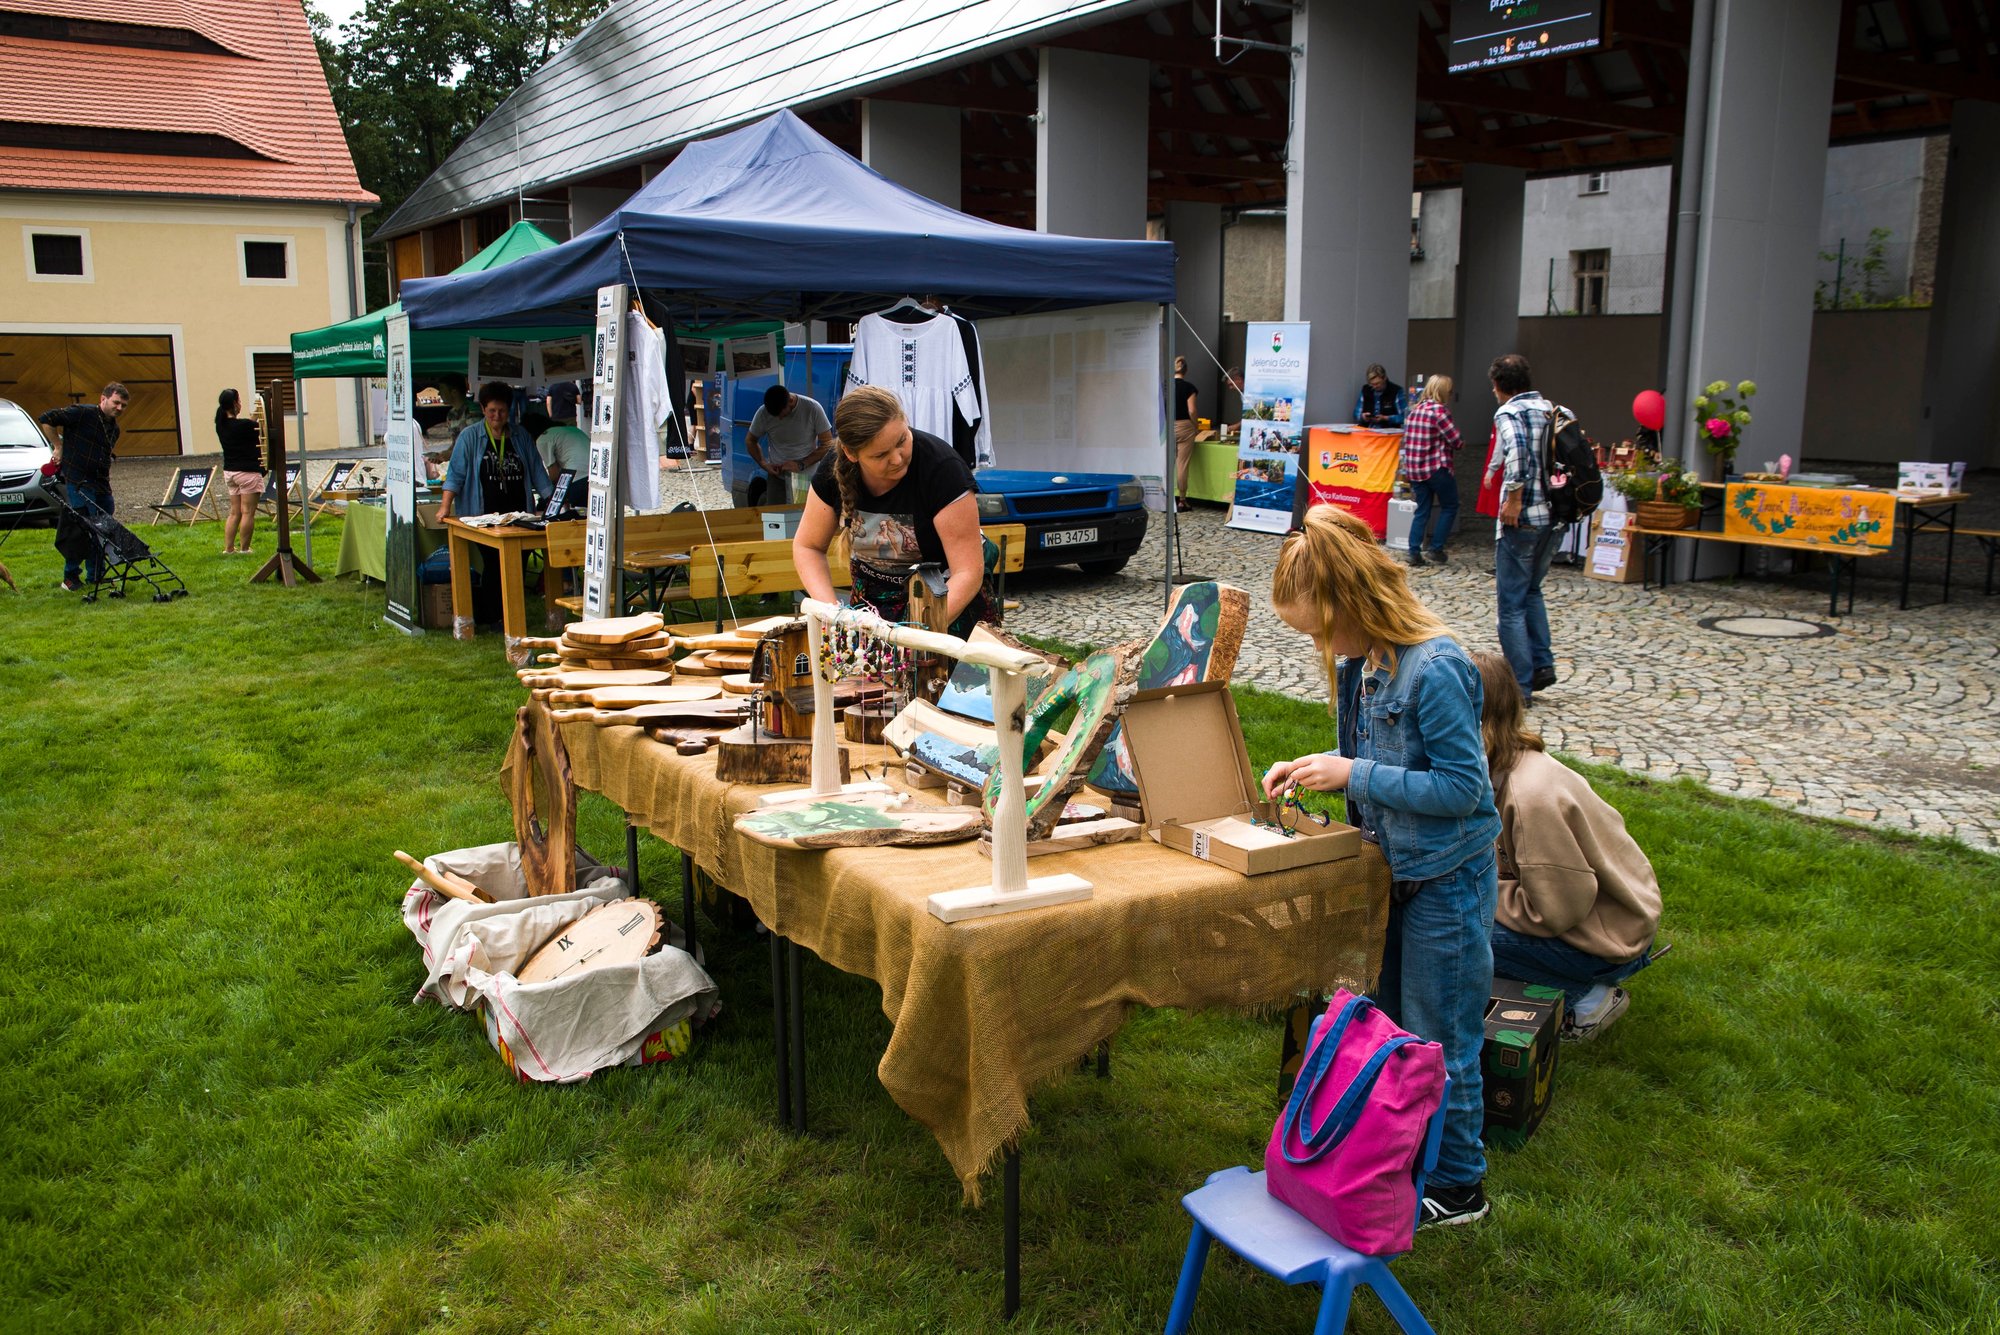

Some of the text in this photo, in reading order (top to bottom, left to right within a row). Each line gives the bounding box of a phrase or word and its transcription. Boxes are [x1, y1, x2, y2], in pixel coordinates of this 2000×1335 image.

[1488, 40, 1537, 56] 19.8 duże
[1251, 357, 1300, 368] Jelenia Góra
[1333, 452, 1359, 462] JELENIA
[1046, 529, 1096, 546] WB 3475J
[876, 573, 903, 584] OFFICE
[556, 934, 575, 952] IX
